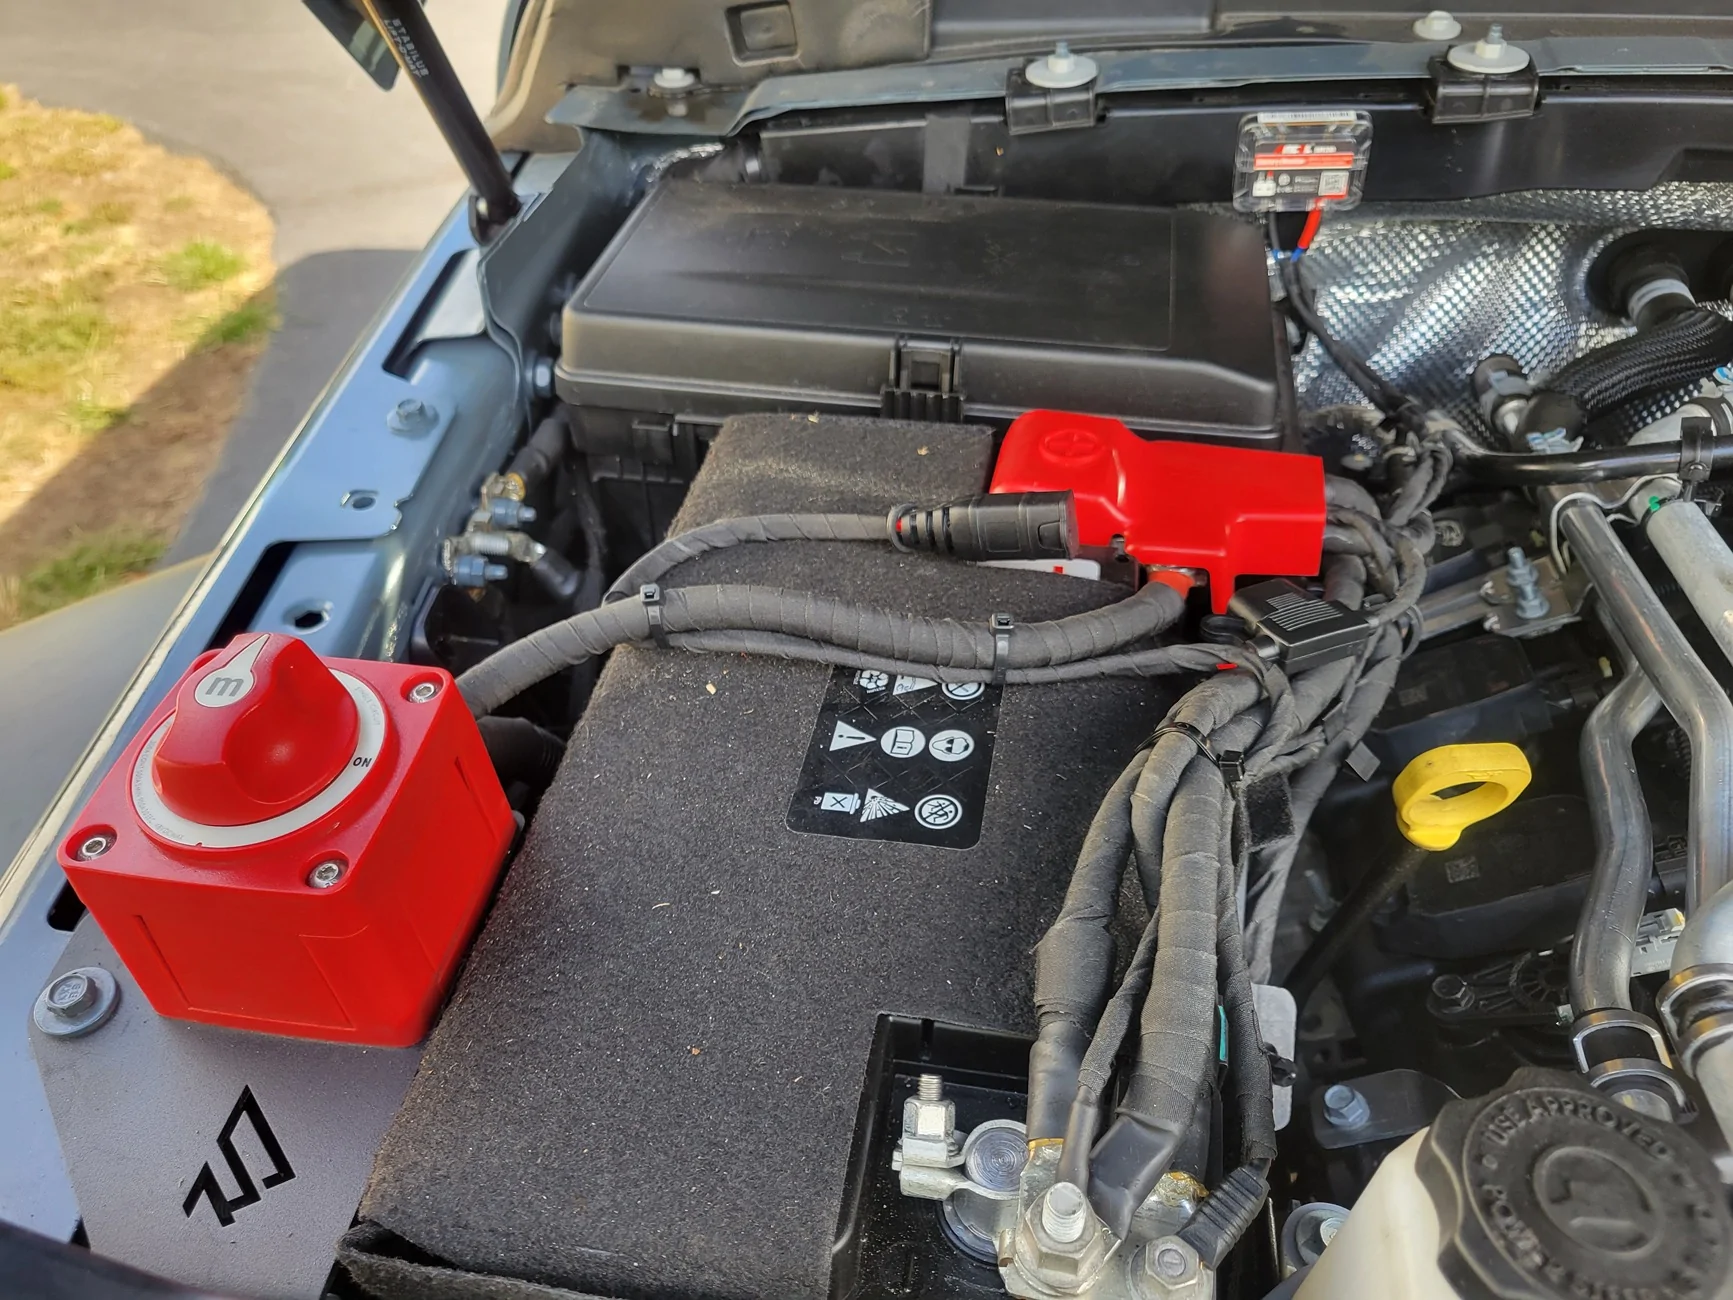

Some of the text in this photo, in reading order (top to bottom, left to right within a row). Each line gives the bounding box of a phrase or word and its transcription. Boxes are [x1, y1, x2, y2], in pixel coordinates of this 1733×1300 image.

[392, 18, 429, 76] STABILUS
[353, 757, 372, 768] ON
[1484, 1096, 1670, 1161] USE APPROVED
